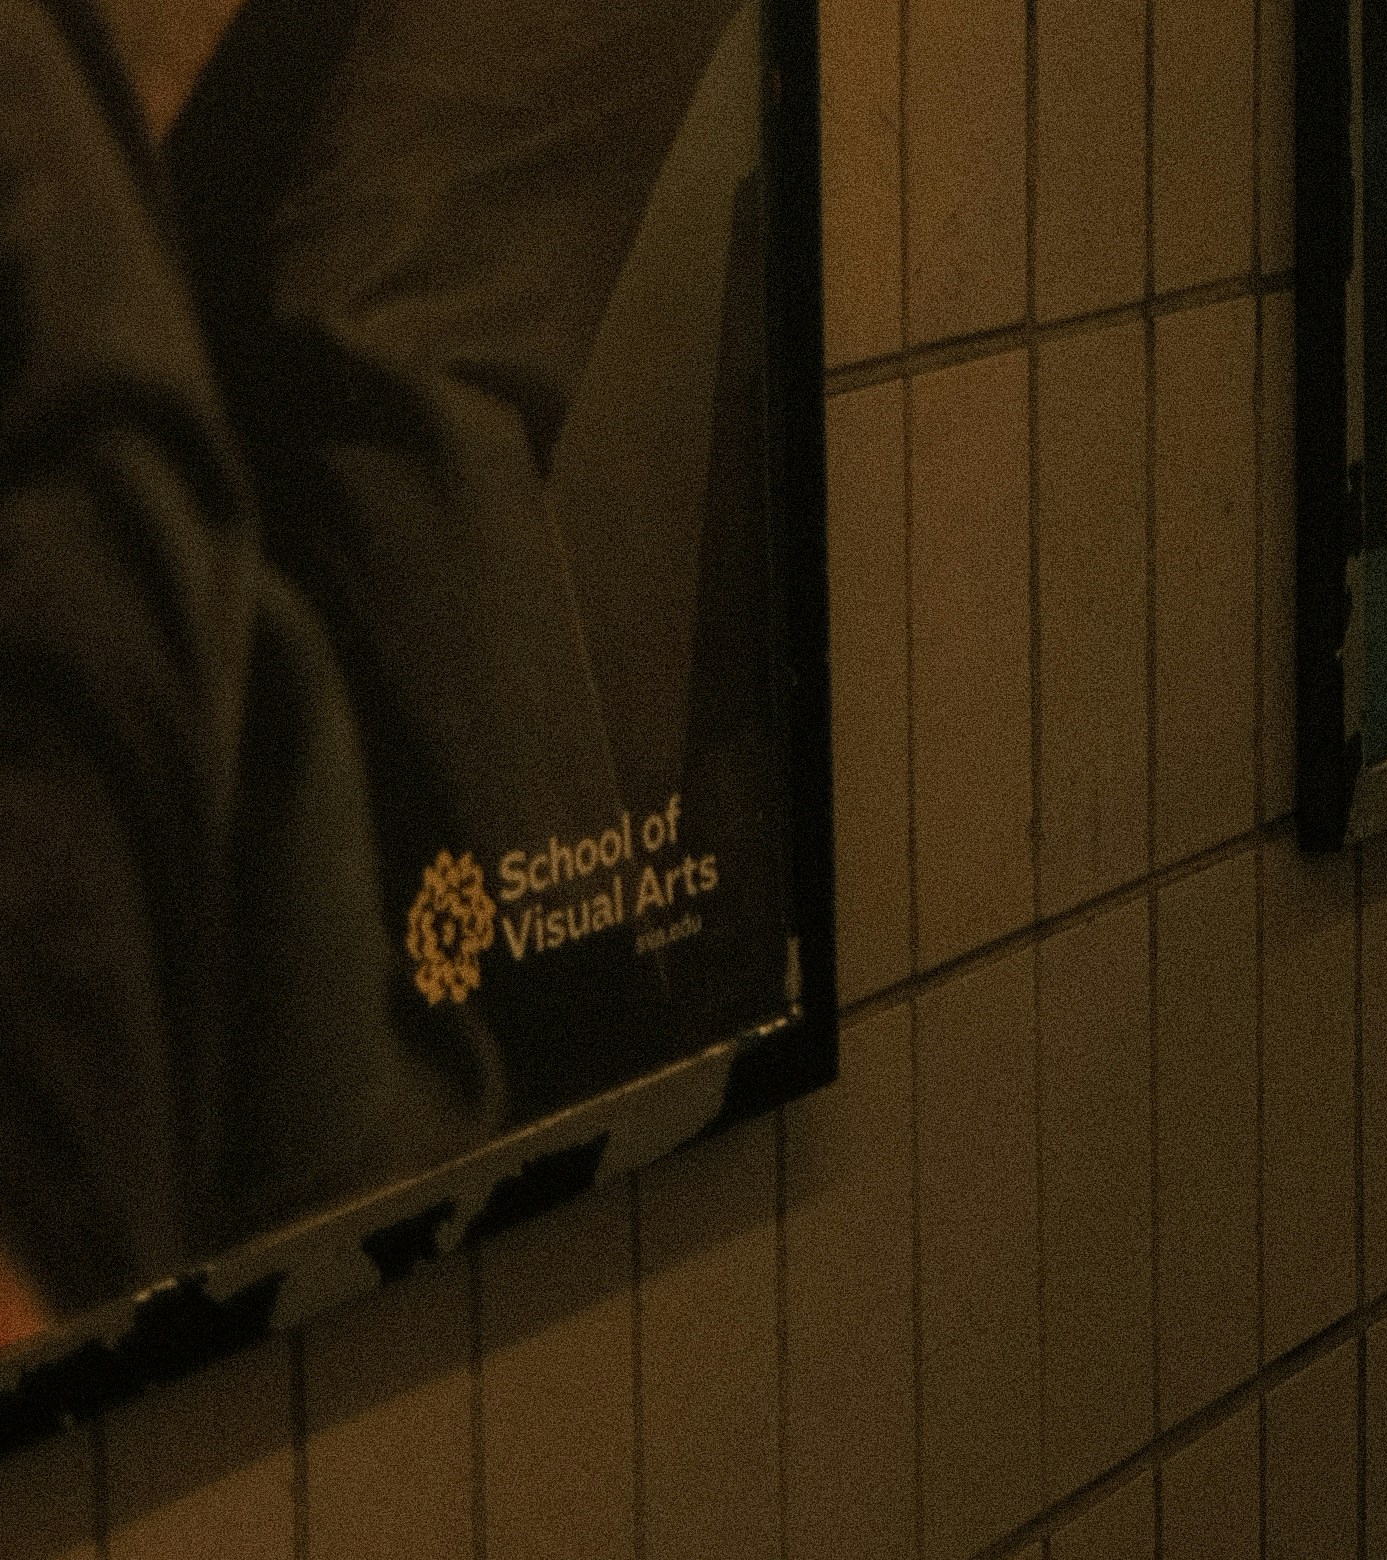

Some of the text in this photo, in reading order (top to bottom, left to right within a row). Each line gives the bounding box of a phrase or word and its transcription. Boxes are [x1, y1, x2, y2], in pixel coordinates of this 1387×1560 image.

[496, 791, 685, 901] School of
[500, 851, 719, 961] Visual Arts
